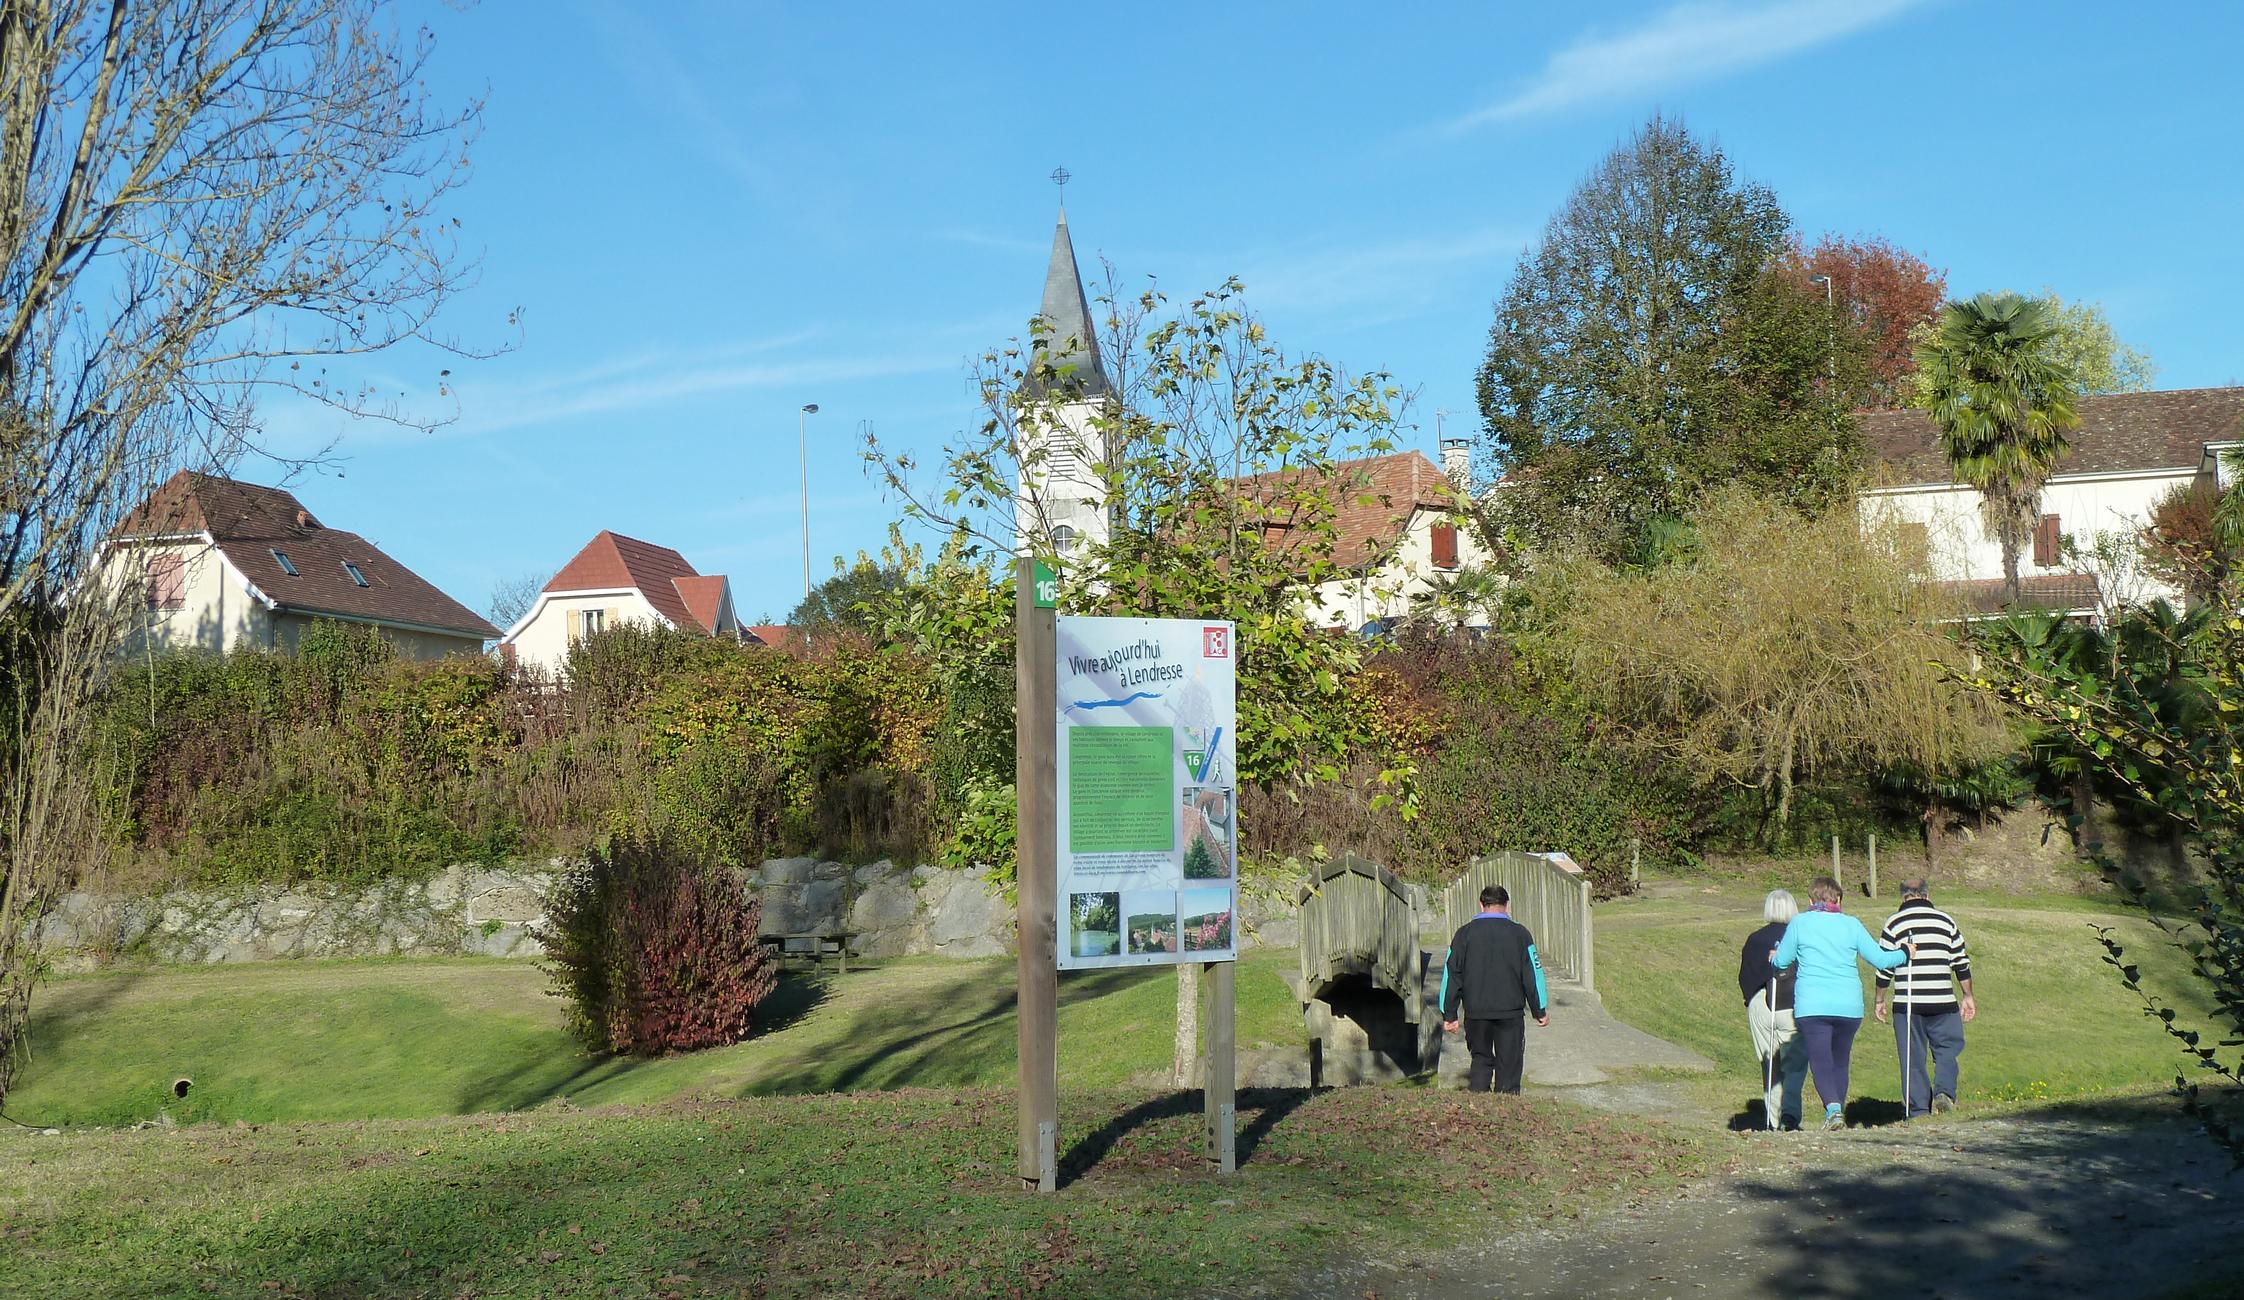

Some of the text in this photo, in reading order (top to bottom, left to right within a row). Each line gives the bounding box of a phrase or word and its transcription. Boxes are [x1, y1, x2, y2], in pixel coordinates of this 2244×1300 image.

[1036, 581, 1056, 602] 16
[1068, 639, 1161, 676] Vivre aujourd'hui
[1120, 661, 1183, 688] à Lendresse
[1187, 755, 1200, 766] 16
